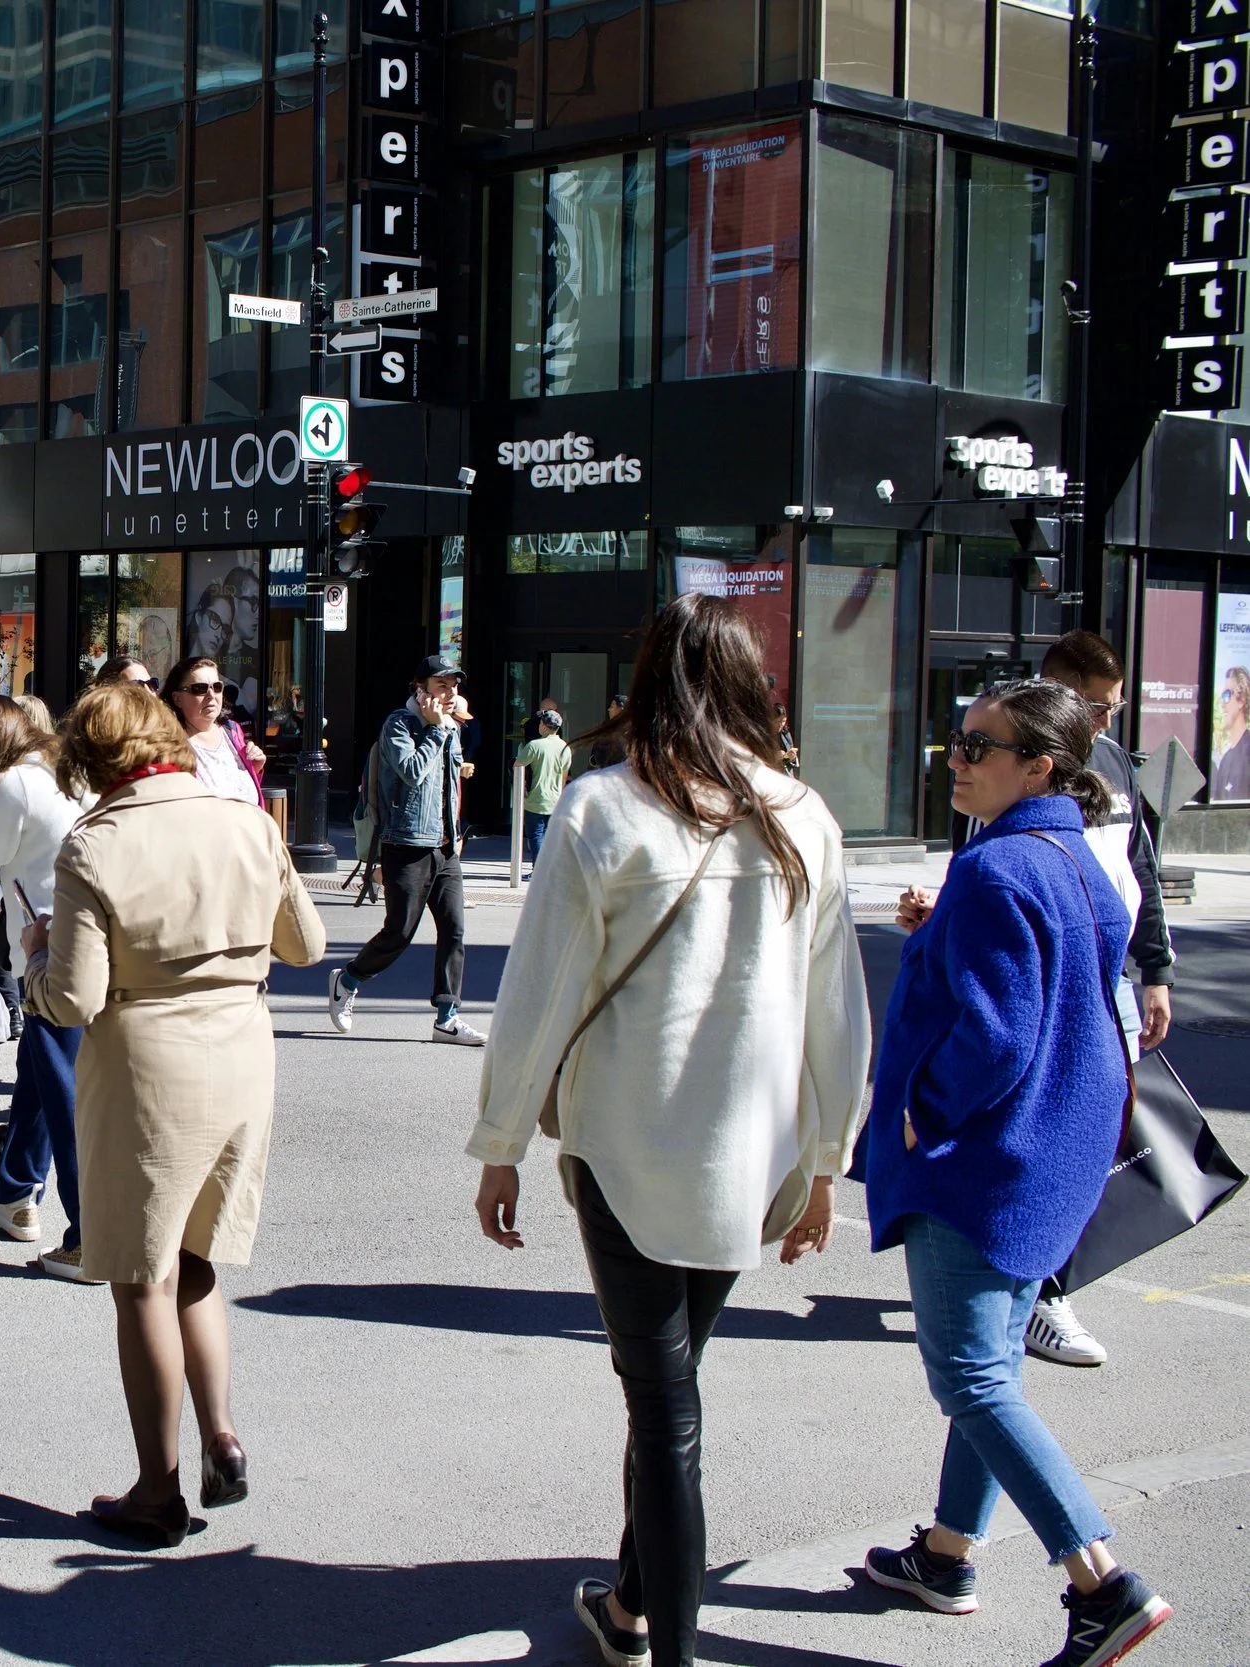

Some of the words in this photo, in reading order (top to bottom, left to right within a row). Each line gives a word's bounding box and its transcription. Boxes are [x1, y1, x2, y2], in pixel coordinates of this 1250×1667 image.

[729, 136, 785, 155] LIQUIDATION
[233, 303, 282, 318] Mansfield
[352, 299, 431, 318] Sainte-Catherine
[105, 429, 309, 498] NEWLOO
[497, 431, 593, 471] sports
[948, 435, 1034, 470] sports
[530, 453, 641, 493] experts
[978, 465, 1068, 498] expets
[106, 500, 303, 537] lunetteri
[689, 570, 718, 584] MÉGA
[719, 570, 784, 585] LIQUIDATION
[1107, 1147, 1152, 1177] MONACO
